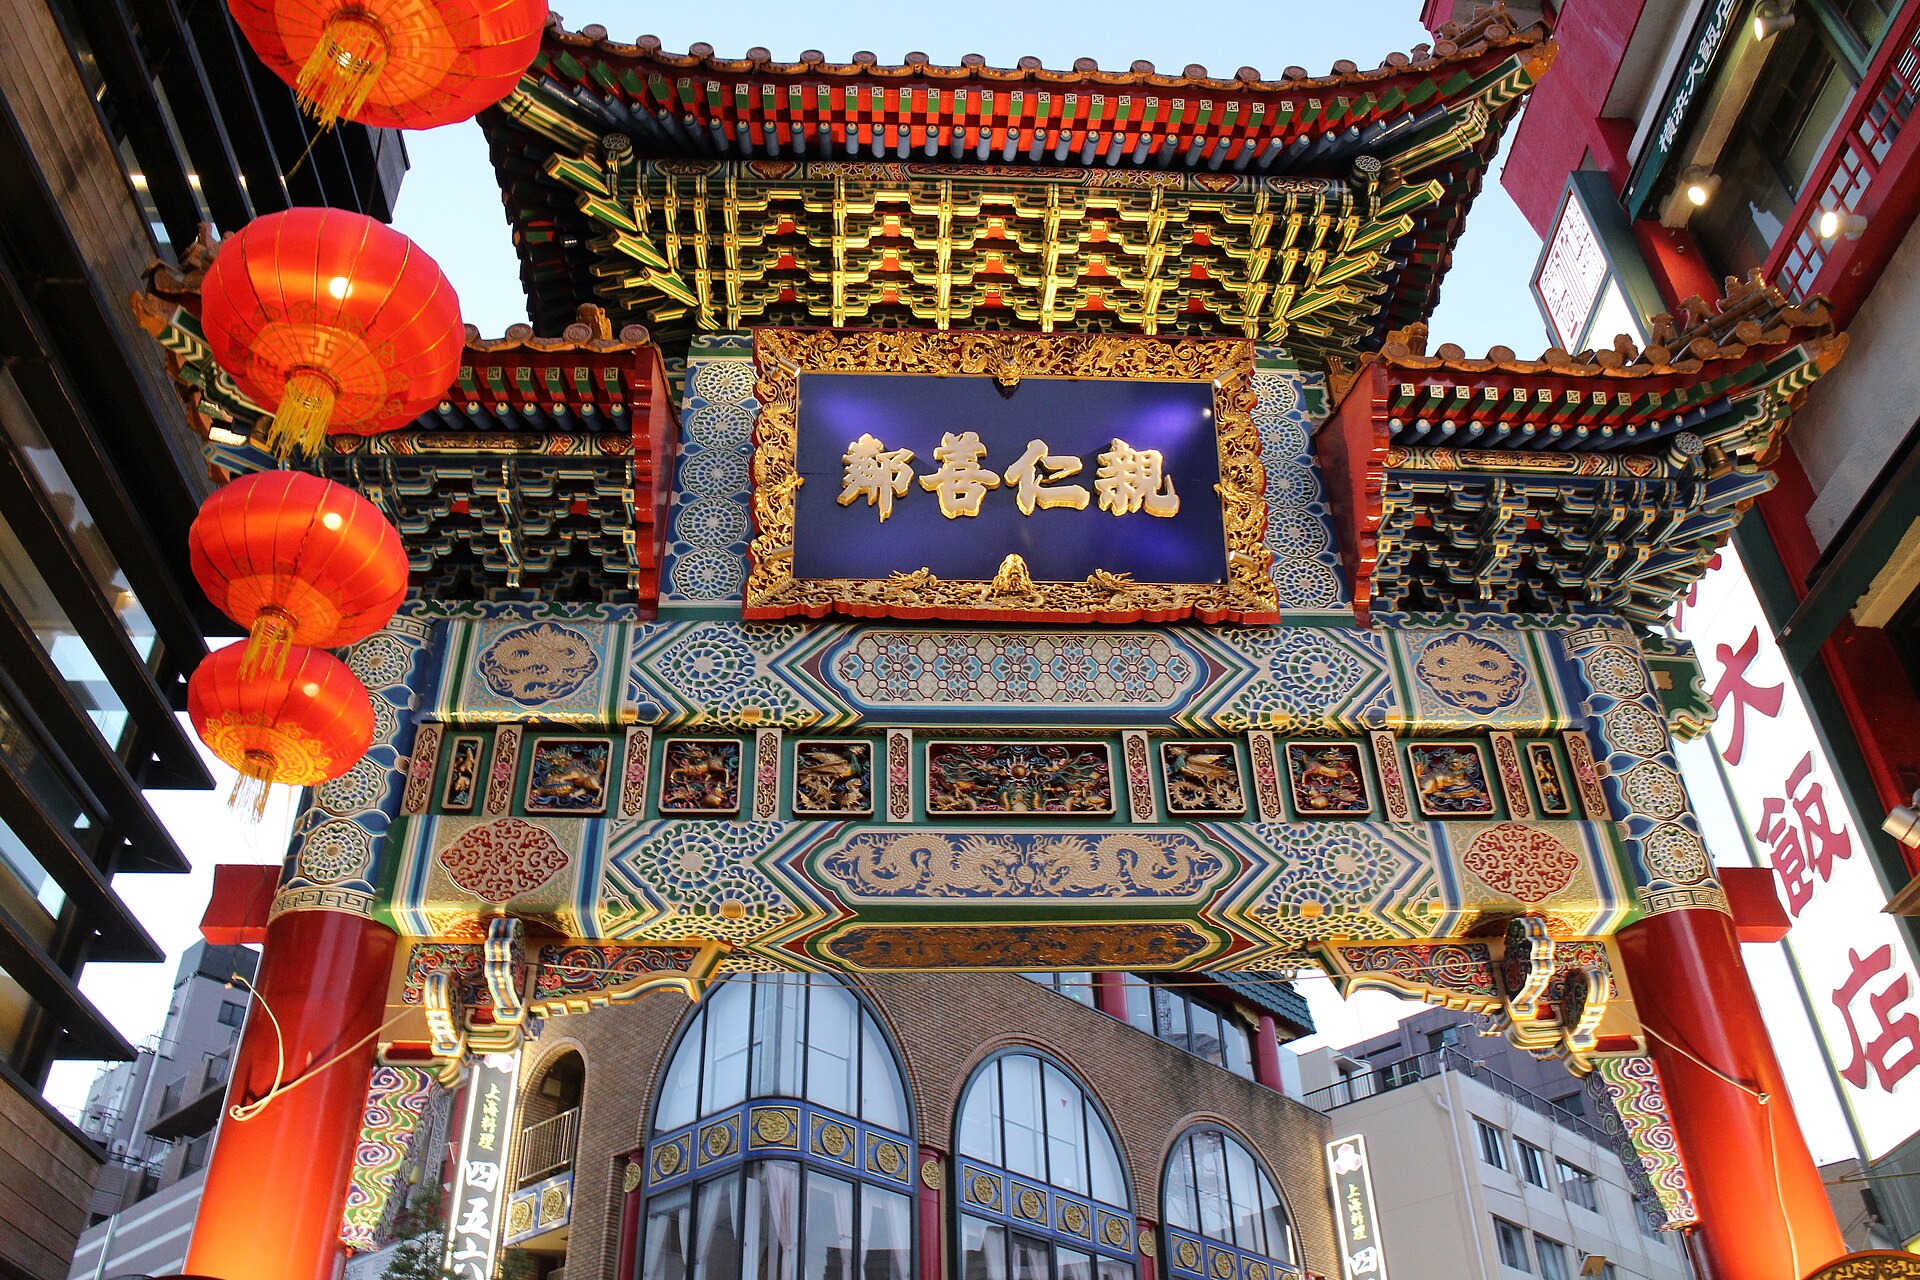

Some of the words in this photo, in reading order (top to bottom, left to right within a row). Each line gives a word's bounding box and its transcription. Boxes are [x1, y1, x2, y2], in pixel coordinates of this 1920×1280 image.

[1673, 553, 1920, 1094] 大飯店
[478, 1083, 501, 1152] 上海料理
[1347, 1184, 1368, 1241] 上海料理
[1349, 1246, 1378, 1280] 四
